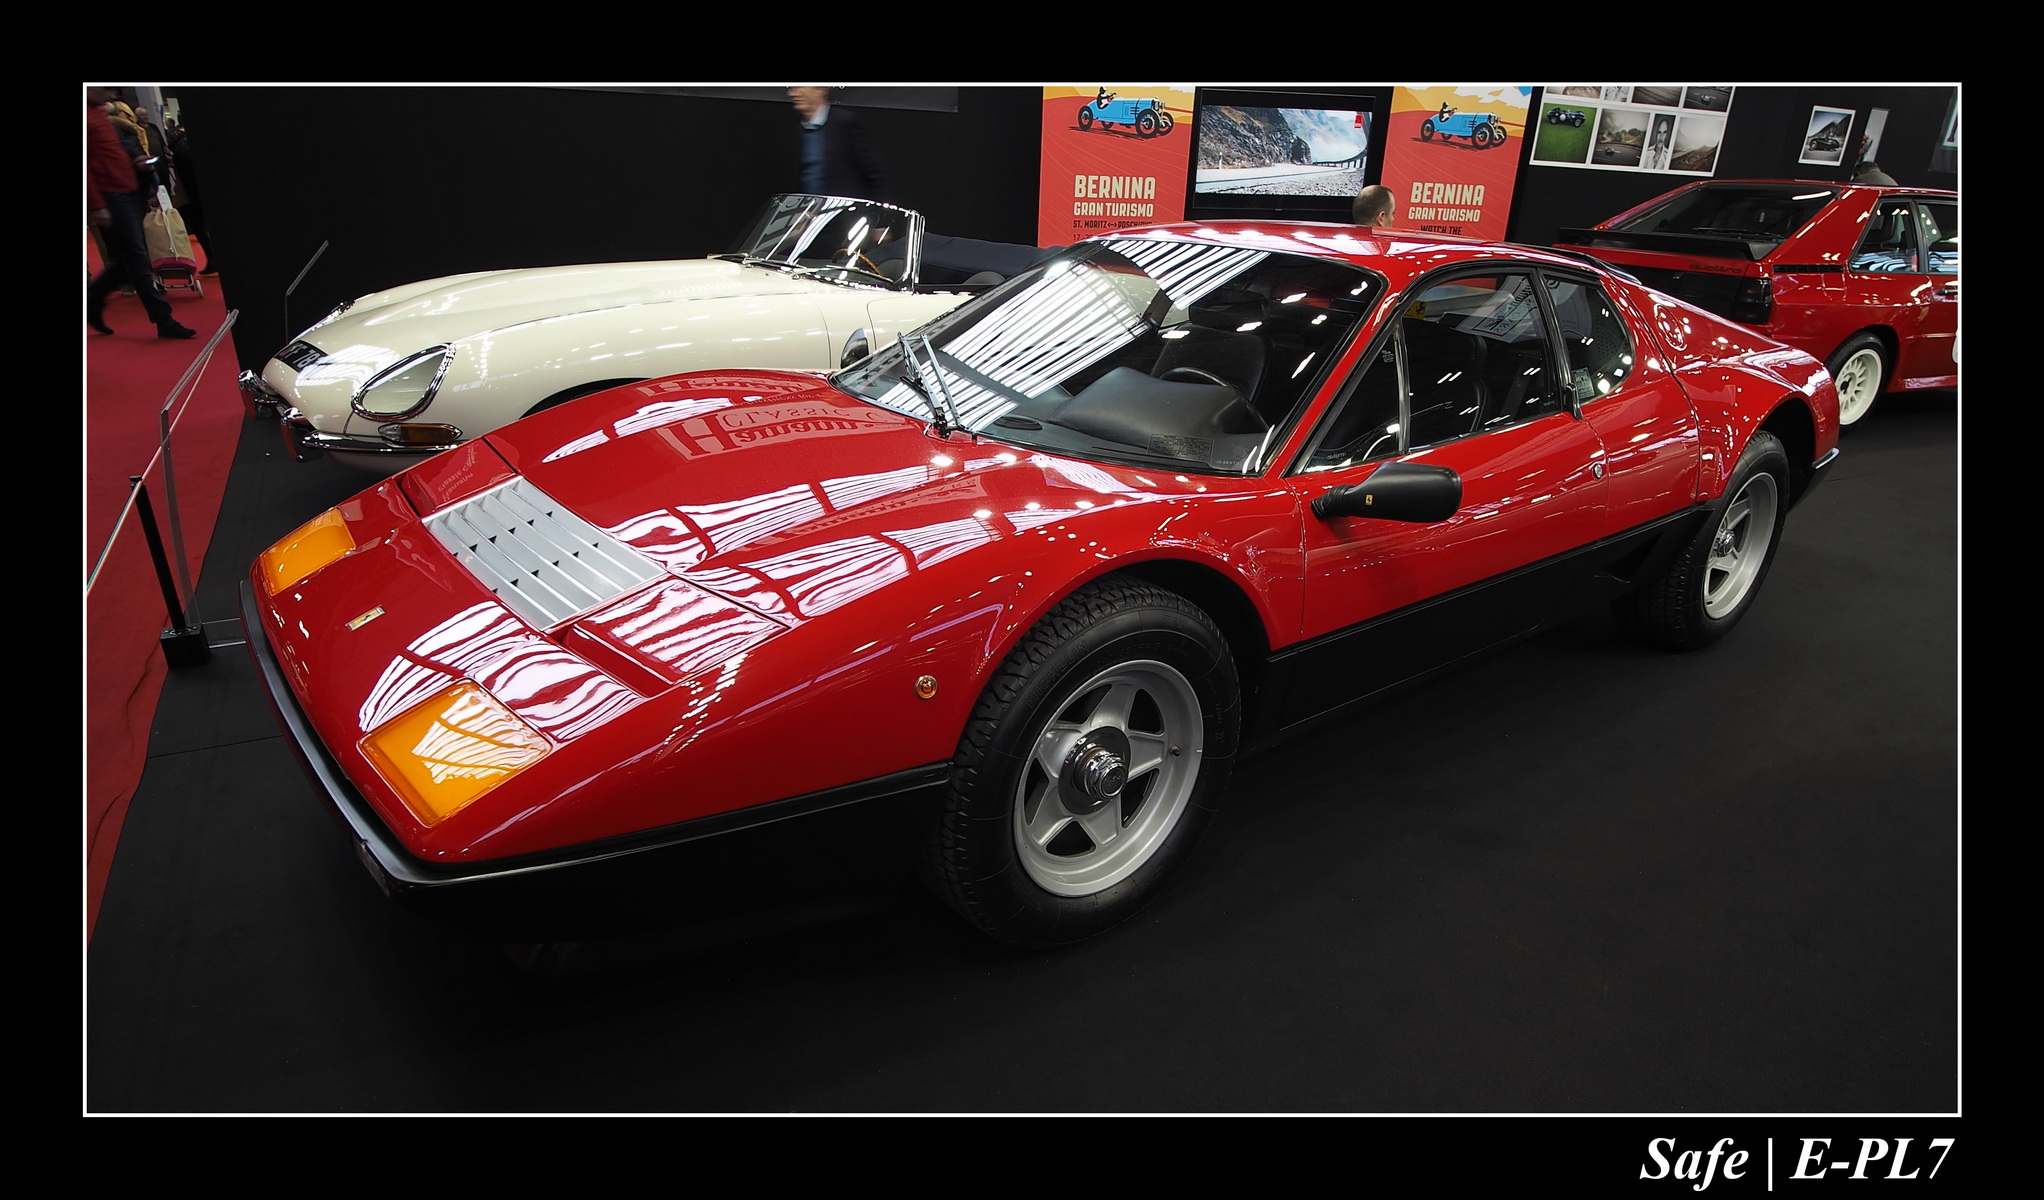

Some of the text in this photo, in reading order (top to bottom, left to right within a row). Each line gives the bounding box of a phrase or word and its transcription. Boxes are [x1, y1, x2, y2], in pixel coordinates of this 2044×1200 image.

[1074, 174, 1156, 200] BERNINA
[1410, 181, 1485, 206] BERNINA
[1073, 201, 1154, 218] GRAN TURISMO
[1408, 206, 1481, 222] GRAN TURISMO
[1073, 220, 1082, 229] ST.
[1449, 226, 1463, 236] THE
[1689, 264, 1742, 274] quattro
[1023, 639, 1090, 708] MICHELIN
